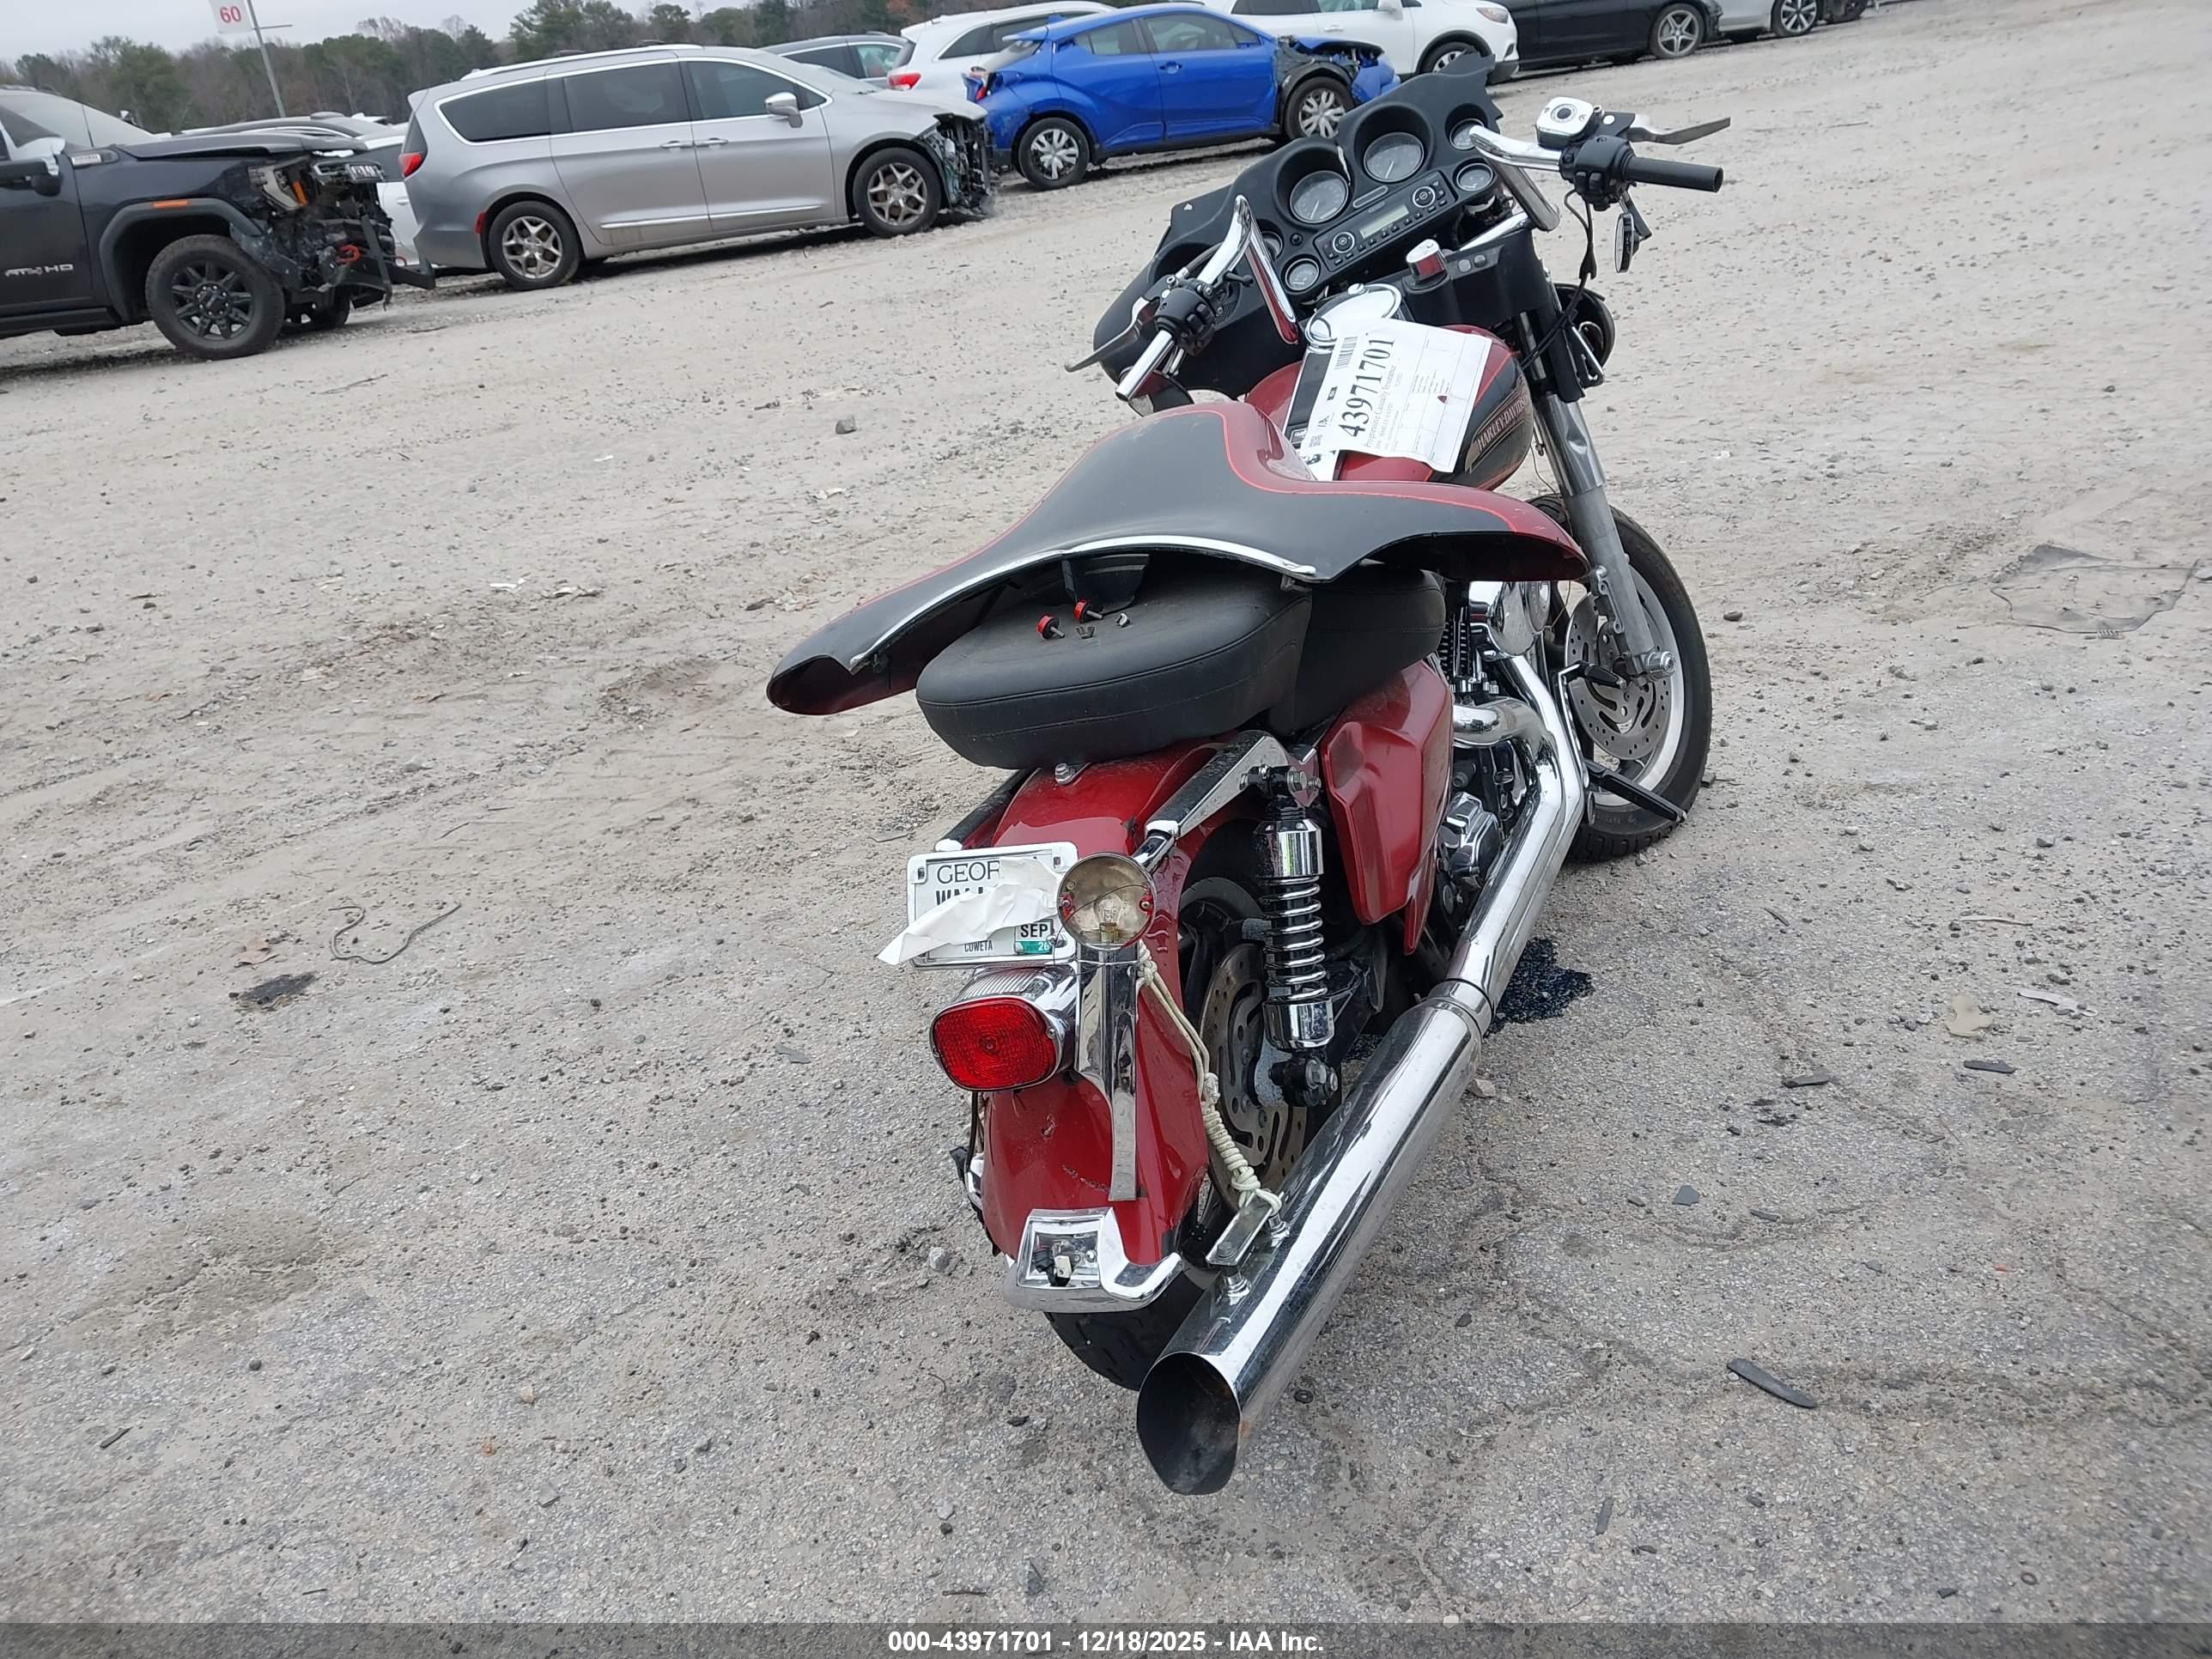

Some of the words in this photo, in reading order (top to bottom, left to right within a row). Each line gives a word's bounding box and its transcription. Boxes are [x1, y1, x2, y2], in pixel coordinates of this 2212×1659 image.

[220, 6, 241, 23] 60
[45, 264, 74, 272] HD
[1338, 339, 1395, 437] 43971701
[1020, 924, 1048, 938] SEP
